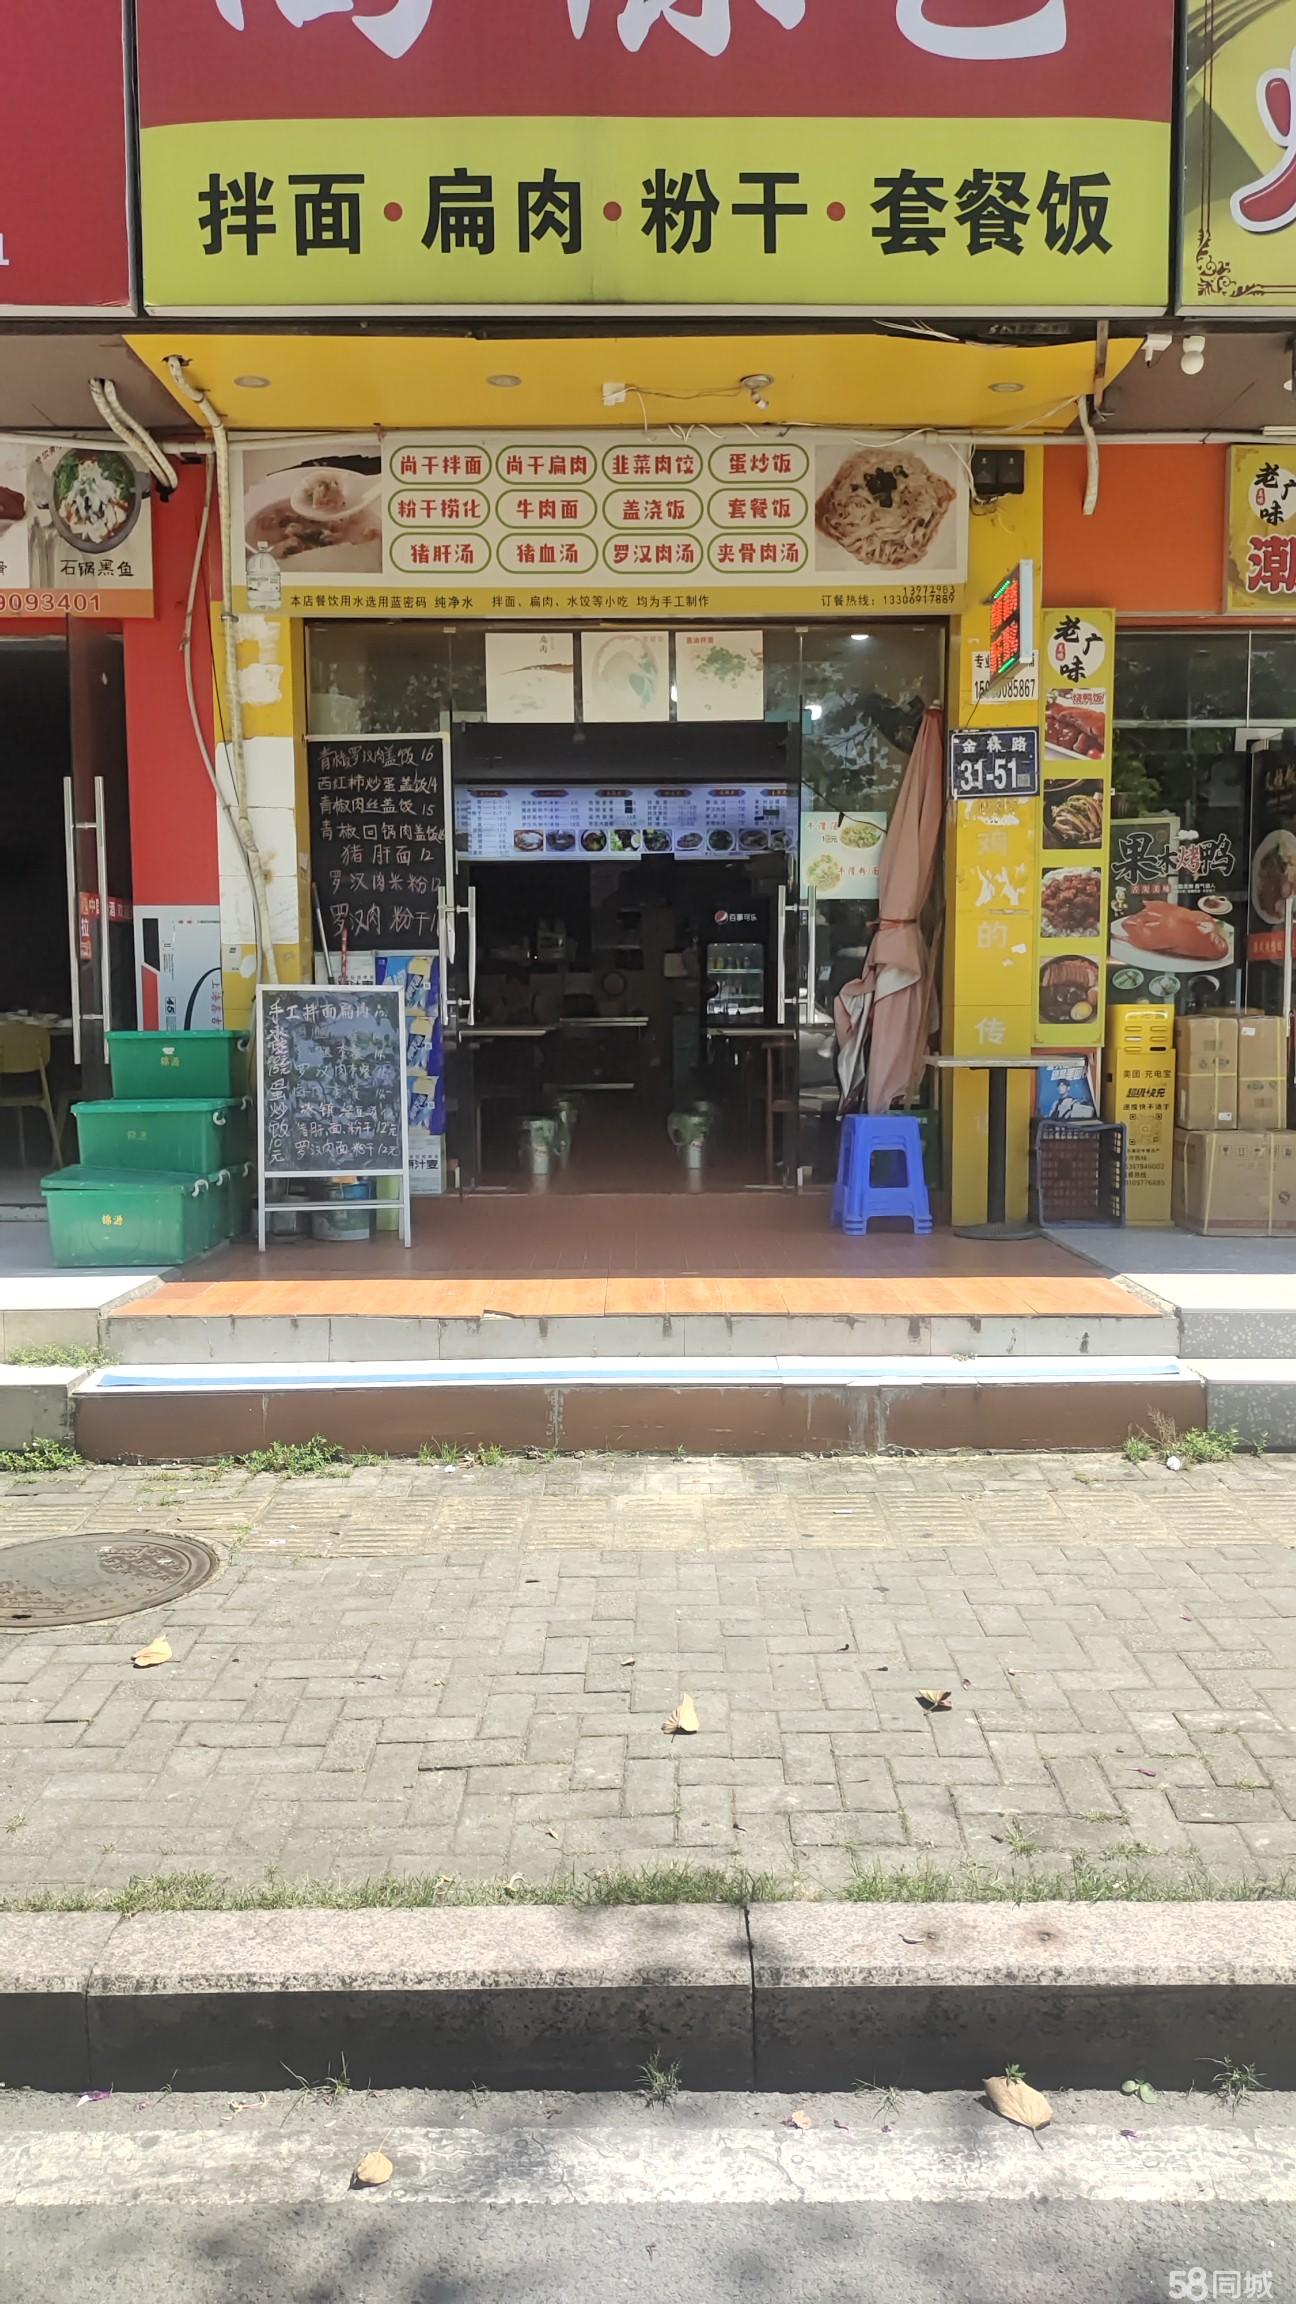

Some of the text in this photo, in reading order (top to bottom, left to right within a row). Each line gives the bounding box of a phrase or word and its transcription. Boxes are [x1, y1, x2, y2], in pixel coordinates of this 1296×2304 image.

[400, 454, 482, 475] 尚干拌面
[506, 454, 588, 475] 尚干扁肉
[612, 454, 694, 475] 韭菜肉饺
[728, 453, 791, 474] 蛋炒饭
[398, 498, 481, 519] 粉干捞化
[516, 499, 579, 519] 牛肉面
[622, 499, 685, 520] 盖浇饭
[728, 498, 791, 519] 套餐饭
[411, 543, 474, 564] 猪肝汤
[517, 543, 578, 564] 猪血汤
[612, 543, 694, 564] 罗汉肉汤
[717, 543, 799, 563] 夹骨肉汤
[60, 559, 134, 577] 石锅黑鱼
[290, 595, 474, 609] 本店餐饮用水选用蓝密码 纯净水
[492, 595, 710, 608] 拌面、扁肉、水饺等小吃 均为手工制作
[962, 736, 1028, 754] 金林路
[960, 760, 1018, 791] 31-51
[421, 804, 435, 817] 15
[341, 843, 435, 867] 猪肝面 12
[1111, 832, 1236, 886] 果木烤鸭
[329, 869, 428, 895] 罗汉肉米粉
[330, 903, 382, 937] 罗汉肉
[390, 904, 430, 937] 粉干
